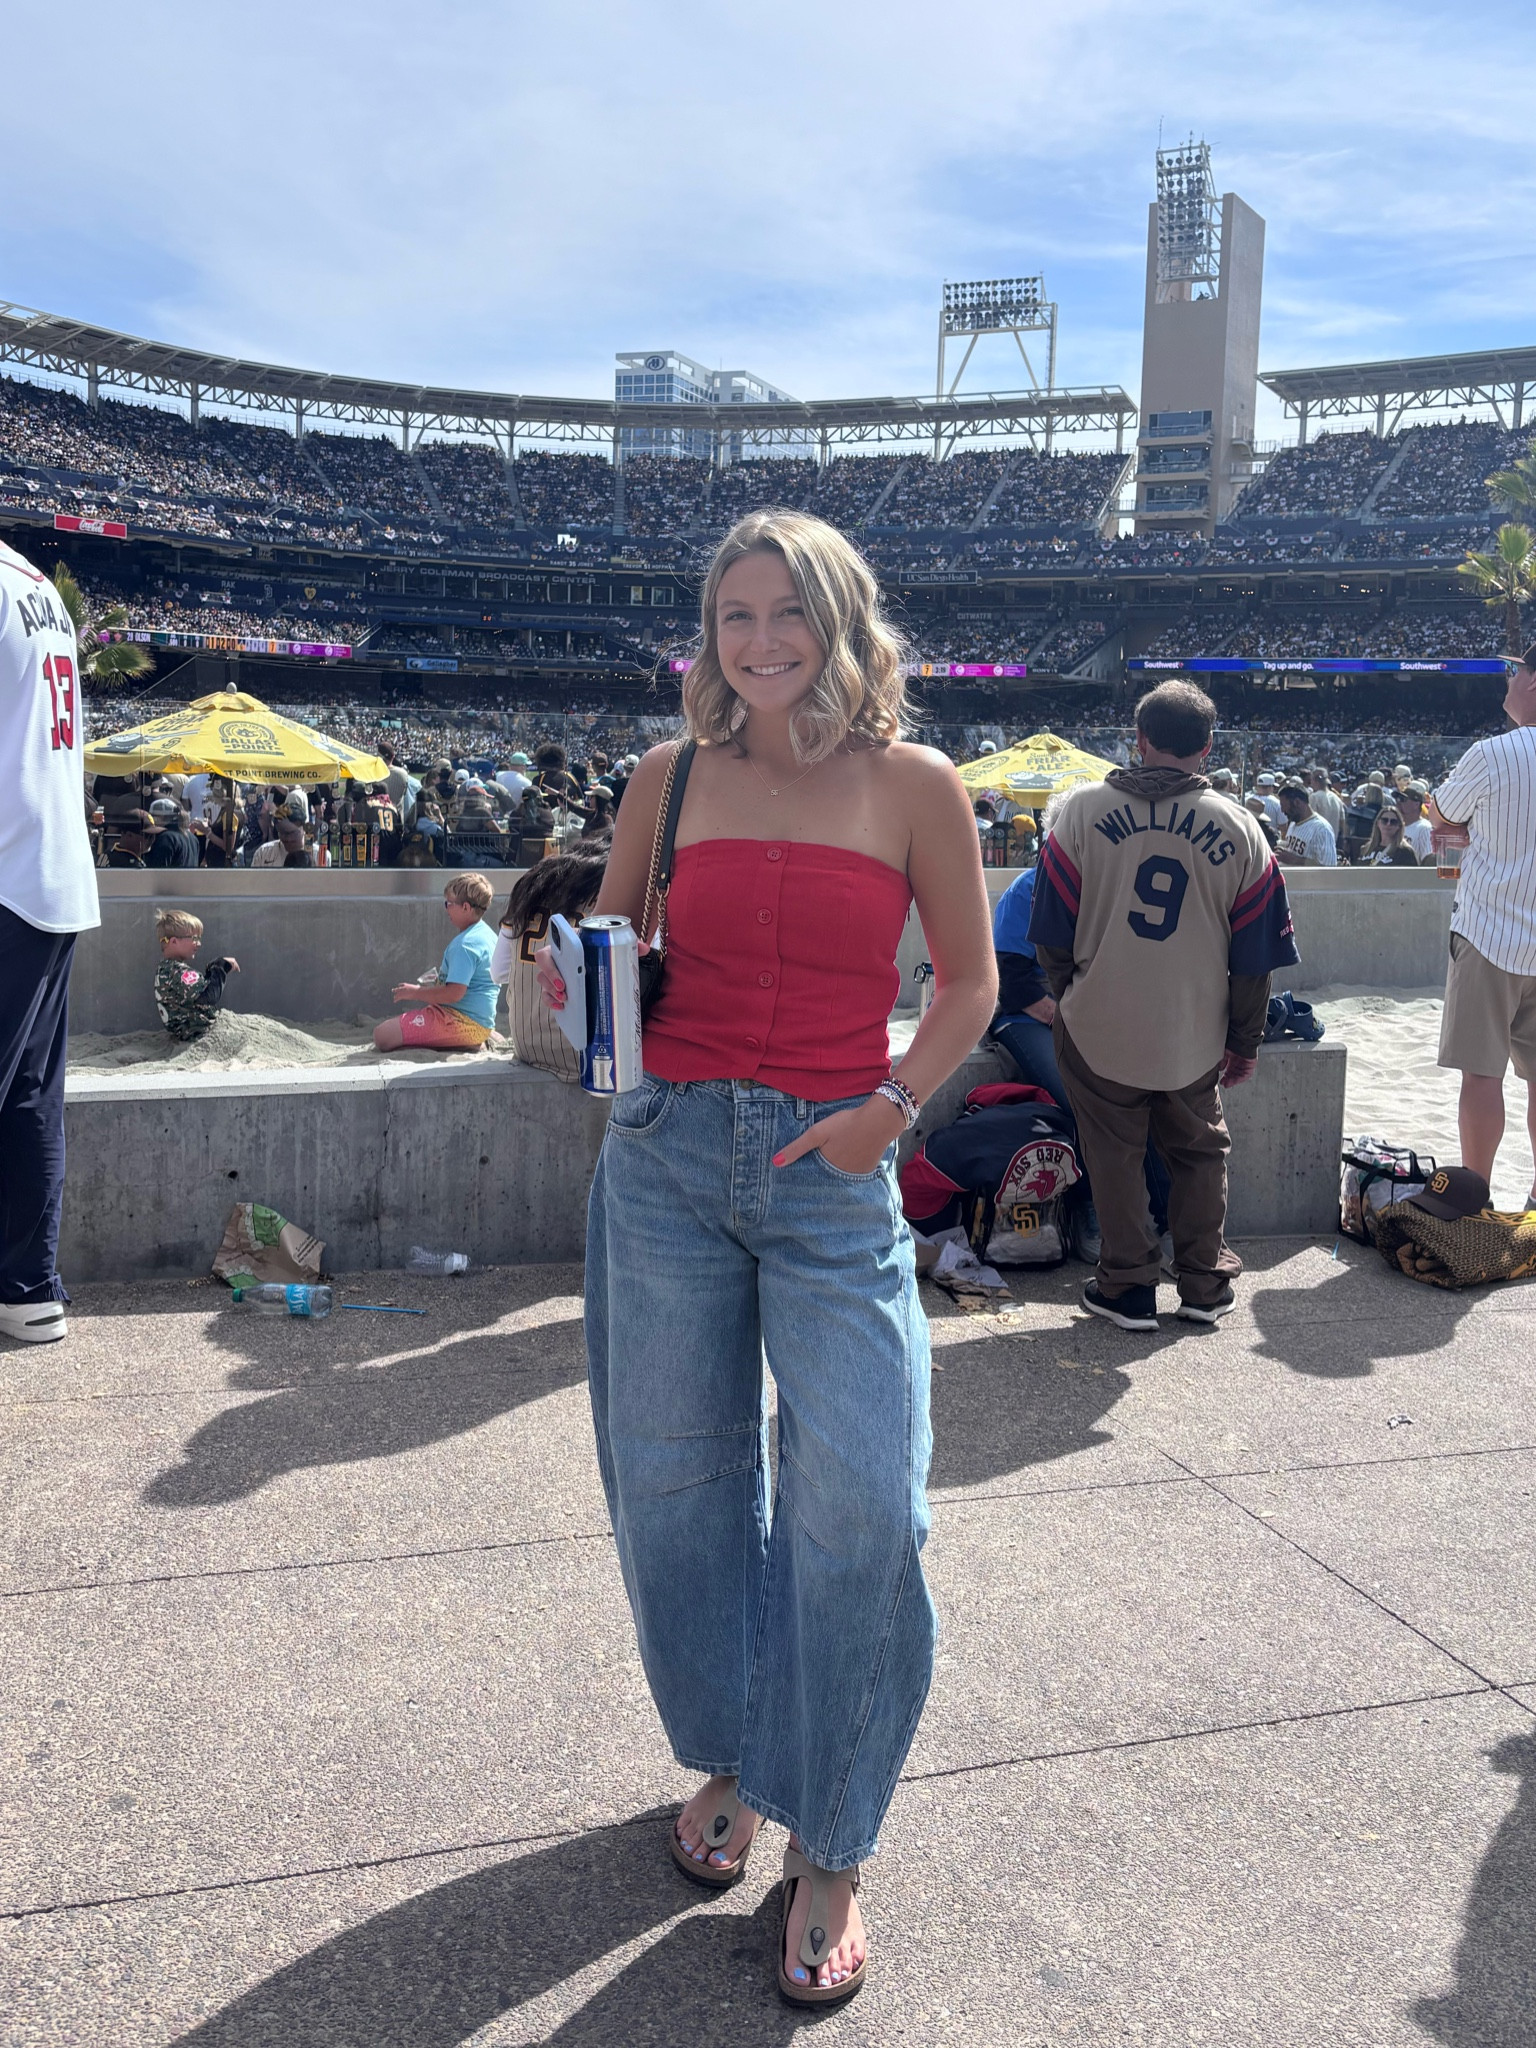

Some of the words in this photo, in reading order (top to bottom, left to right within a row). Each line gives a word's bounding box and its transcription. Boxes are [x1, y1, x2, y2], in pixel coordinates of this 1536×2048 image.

[380, 565, 415, 574] JERRY
[420, 567, 474, 578] COLEMAN
[478, 572, 547, 582] BROADCAST
[552, 576, 596, 584] CENTER
[221, 580, 235, 589] RAK
[135, 632, 151, 642] OLSON
[426, 660, 456, 668] Gallagher
[1263, 662, 1276, 671] Tag
[42, 652, 74, 750] 13
[1026, 755, 1070, 765] FRIAR
[1036, 762, 1064, 771] ALE
[236, 770, 262, 778] POINT
[378, 809, 393, 832] 13
[1094, 801, 1236, 866] WILLIAMS
[1127, 855, 1189, 942] 9
[1036, 1147, 1065, 1163] RED
[1009, 1156, 1031, 1187] SOX
[1431, 1172, 1449, 1194] SD
[1013, 1203, 1039, 1238] SD
